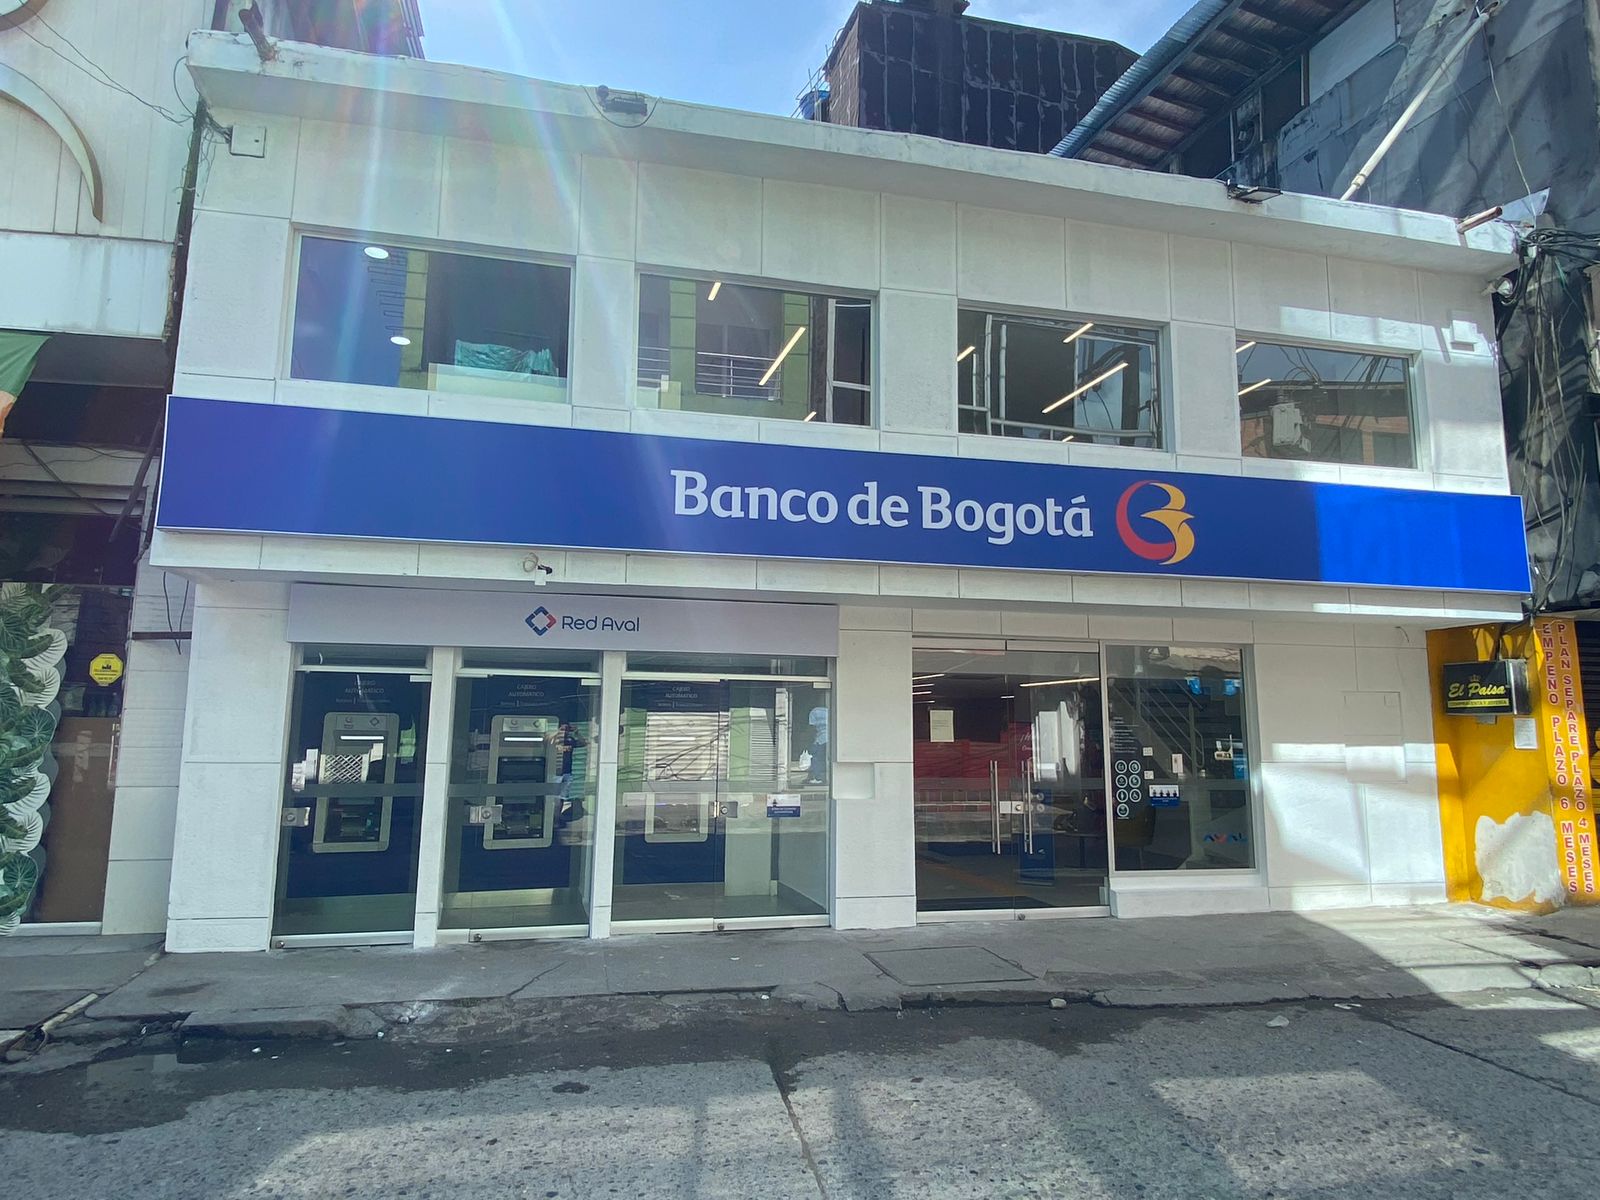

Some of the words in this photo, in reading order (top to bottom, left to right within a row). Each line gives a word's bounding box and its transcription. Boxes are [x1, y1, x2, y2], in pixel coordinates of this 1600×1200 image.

[670, 469, 838, 524] Banco
[847, 481, 909, 528] de
[917, 486, 1094, 546] Bogotá
[561, 615, 598, 631] Red
[601, 616, 640, 632] Aval
[1558, 624, 1571, 669] PLAN
[1448, 683, 1465, 698] El
[1468, 682, 1506, 697] Paisa
[1563, 675, 1579, 745] SEPARE
[1552, 716, 1567, 785] PLAZO
[1560, 798, 1569, 809] 6
[1571, 752, 1586, 811] PLAZO
[1579, 818, 1588, 827] 4
[1561, 822, 1578, 893] MESES
[1579, 834, 1594, 893] MESES
